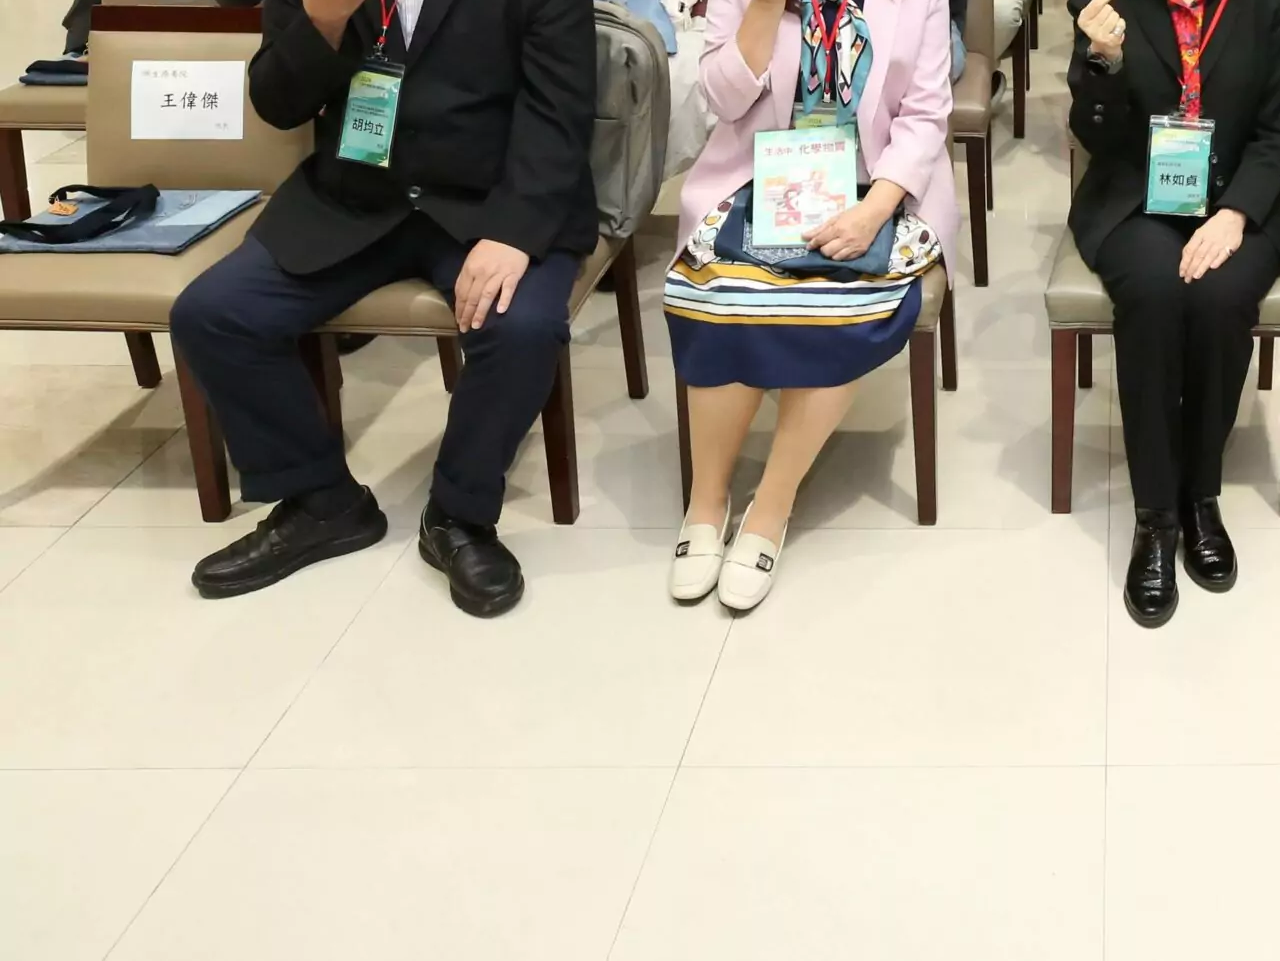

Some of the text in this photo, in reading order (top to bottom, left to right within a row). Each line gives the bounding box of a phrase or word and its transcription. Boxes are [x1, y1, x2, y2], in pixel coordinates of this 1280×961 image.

[160, 91, 219, 110] 王偉傑
[352, 118, 384, 136] 胡均立
[1160, 173, 1198, 187] 林如貞
